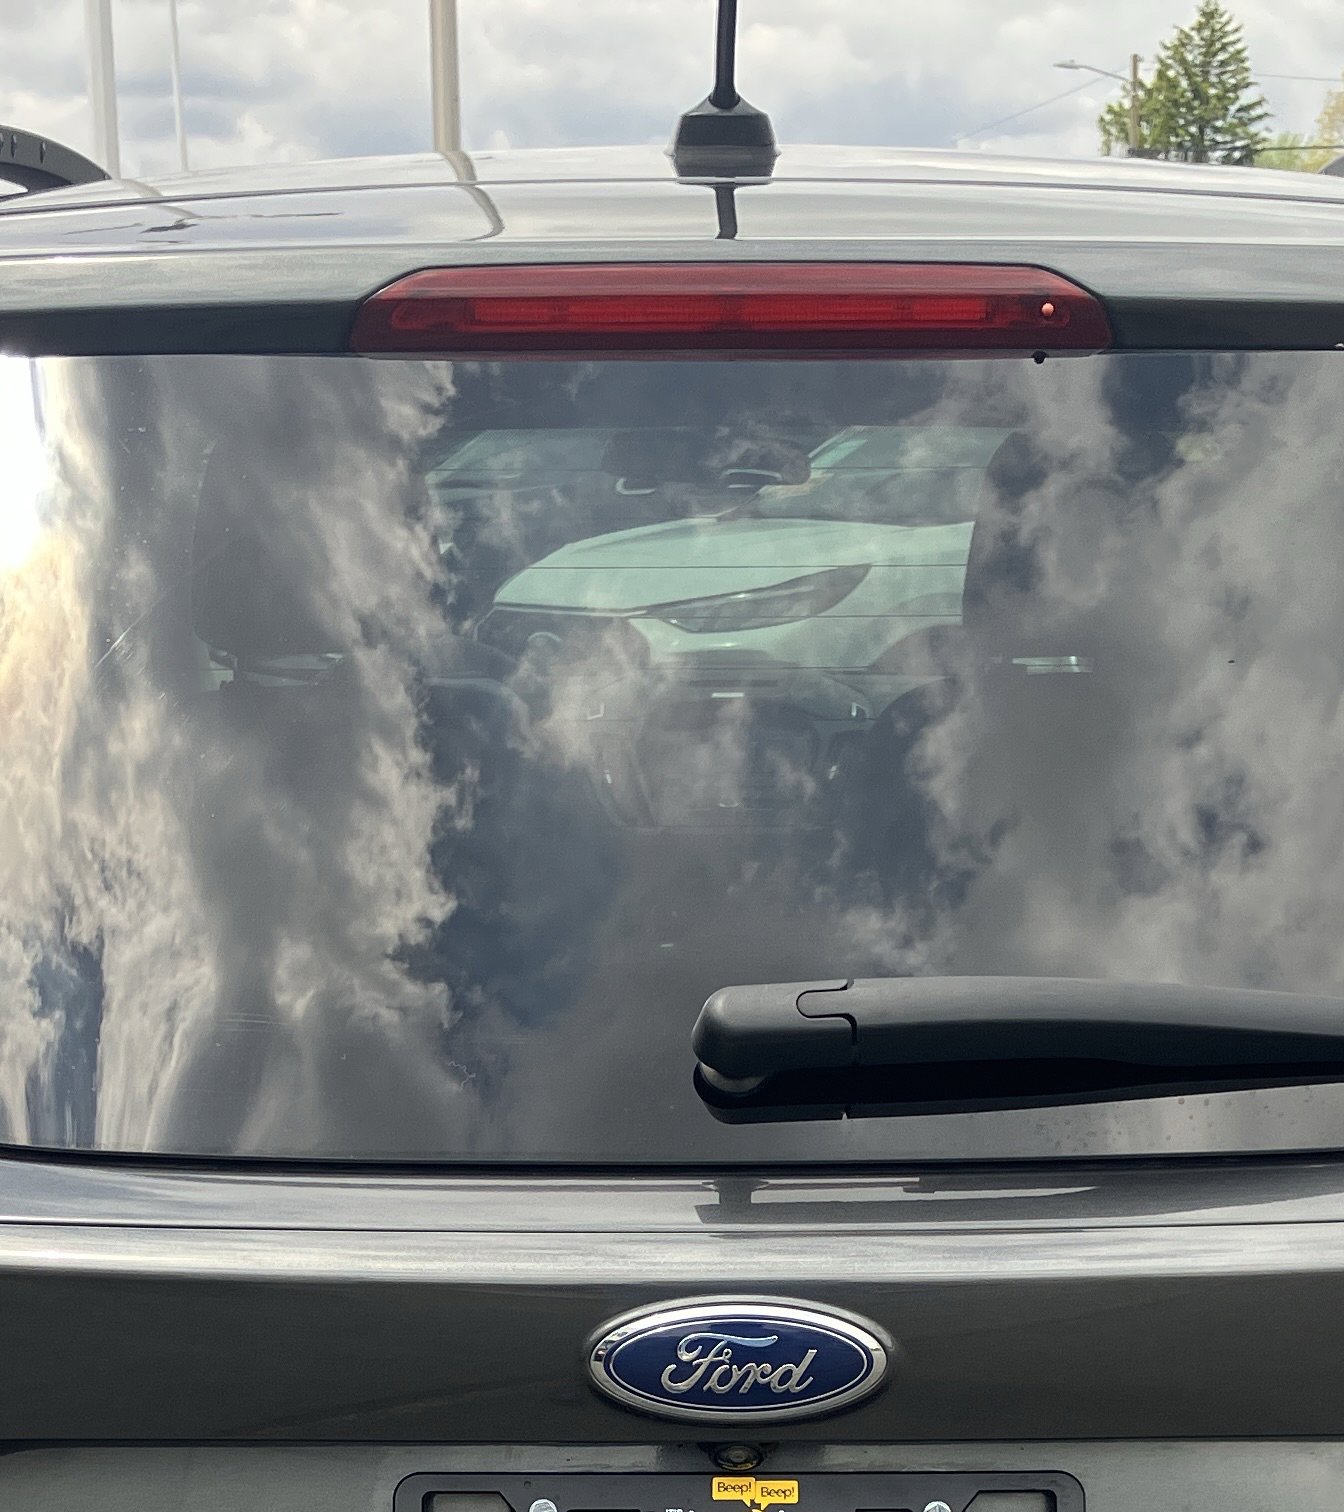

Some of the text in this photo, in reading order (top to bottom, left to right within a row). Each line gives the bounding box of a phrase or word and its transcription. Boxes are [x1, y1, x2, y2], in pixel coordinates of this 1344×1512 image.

[661, 1333, 818, 1394] Ford
[717, 1481, 795, 1499] Beep! Beep!
